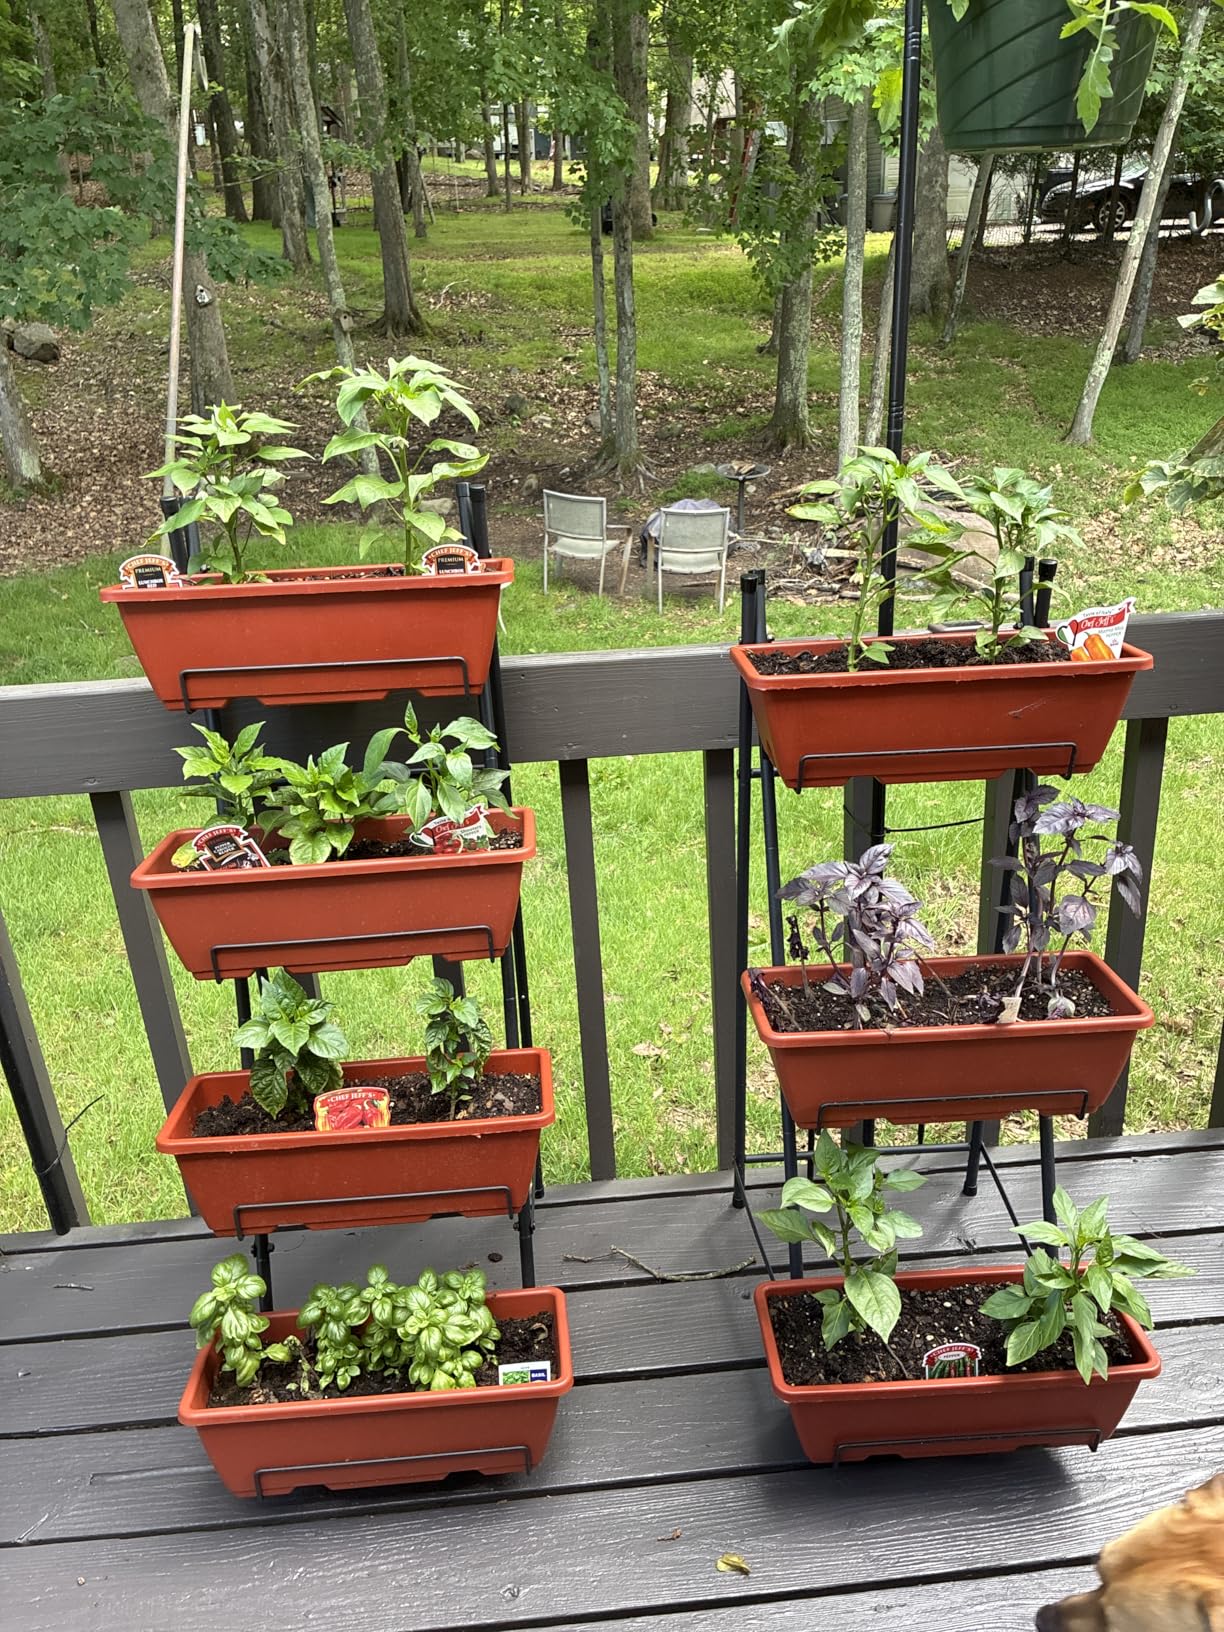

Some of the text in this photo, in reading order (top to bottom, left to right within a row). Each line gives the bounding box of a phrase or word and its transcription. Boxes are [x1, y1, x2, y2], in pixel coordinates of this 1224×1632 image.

[1080, 615, 1114, 629] Chef Jeff's
[435, 823, 450, 833] Chef
[330, 1093, 349, 1102] CHEF
